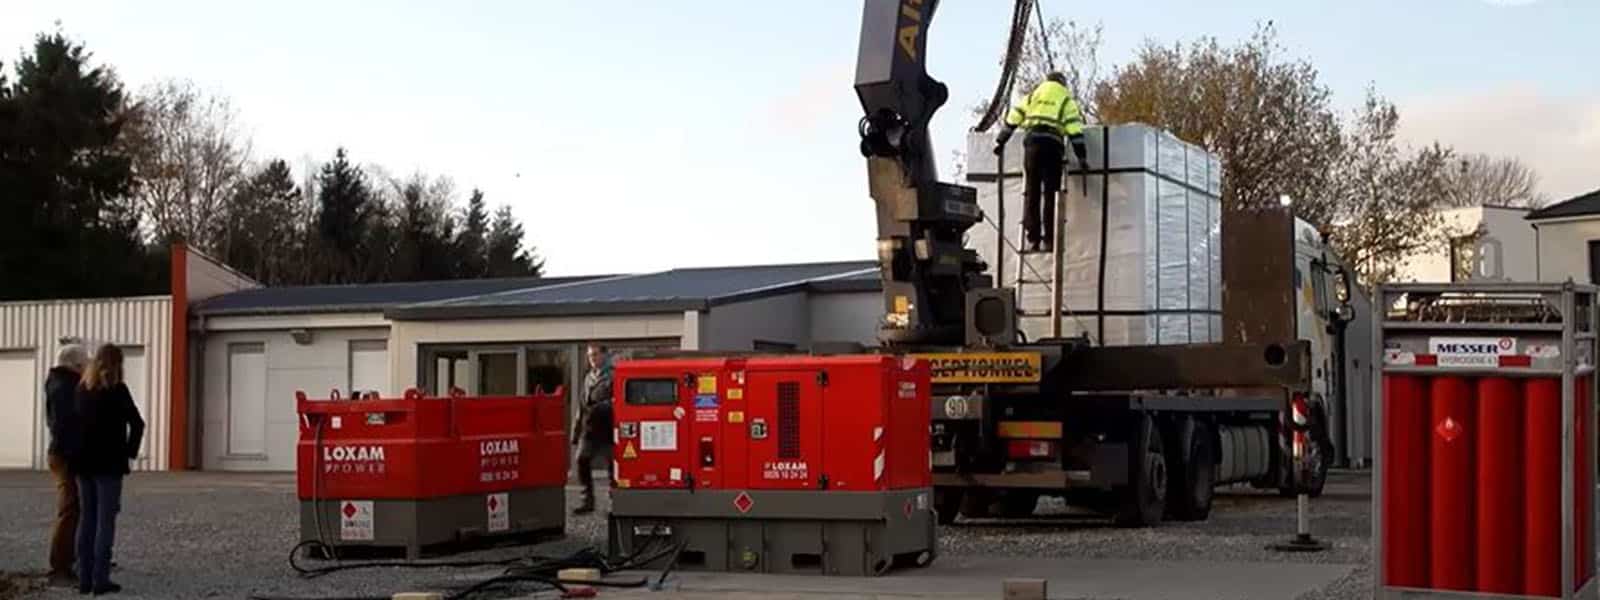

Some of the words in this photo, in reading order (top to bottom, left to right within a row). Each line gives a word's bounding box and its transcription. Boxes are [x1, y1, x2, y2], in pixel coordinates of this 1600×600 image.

[1437, 344, 1499, 354] MESSER
[949, 398, 963, 416] 90
[324, 446, 384, 460] LOXAM
[480, 440, 519, 456] LOXAM
[772, 462, 807, 470] LOXAM
